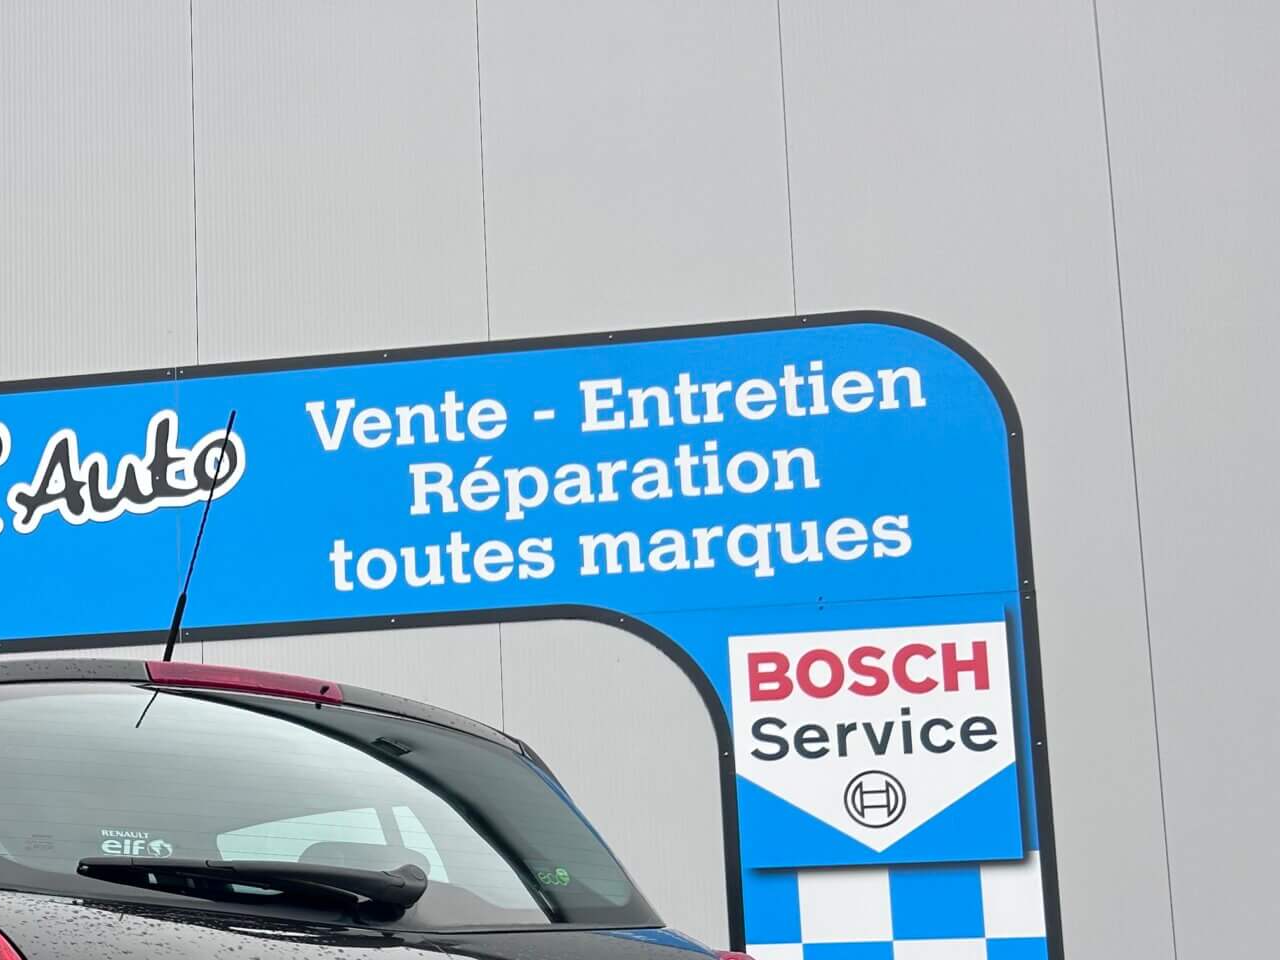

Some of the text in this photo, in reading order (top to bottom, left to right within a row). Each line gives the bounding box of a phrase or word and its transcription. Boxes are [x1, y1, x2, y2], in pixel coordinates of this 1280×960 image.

[306, 390, 508, 451] Vente
[580, 359, 927, 433] Entretien
[408, 444, 821, 521] Réparation
[329, 514, 913, 592] toutes marques
[747, 640, 990, 702] BOSCH
[750, 707, 998, 762] Service
[101, 829, 151, 839] RENAULT
[101, 839, 145, 855] elf
